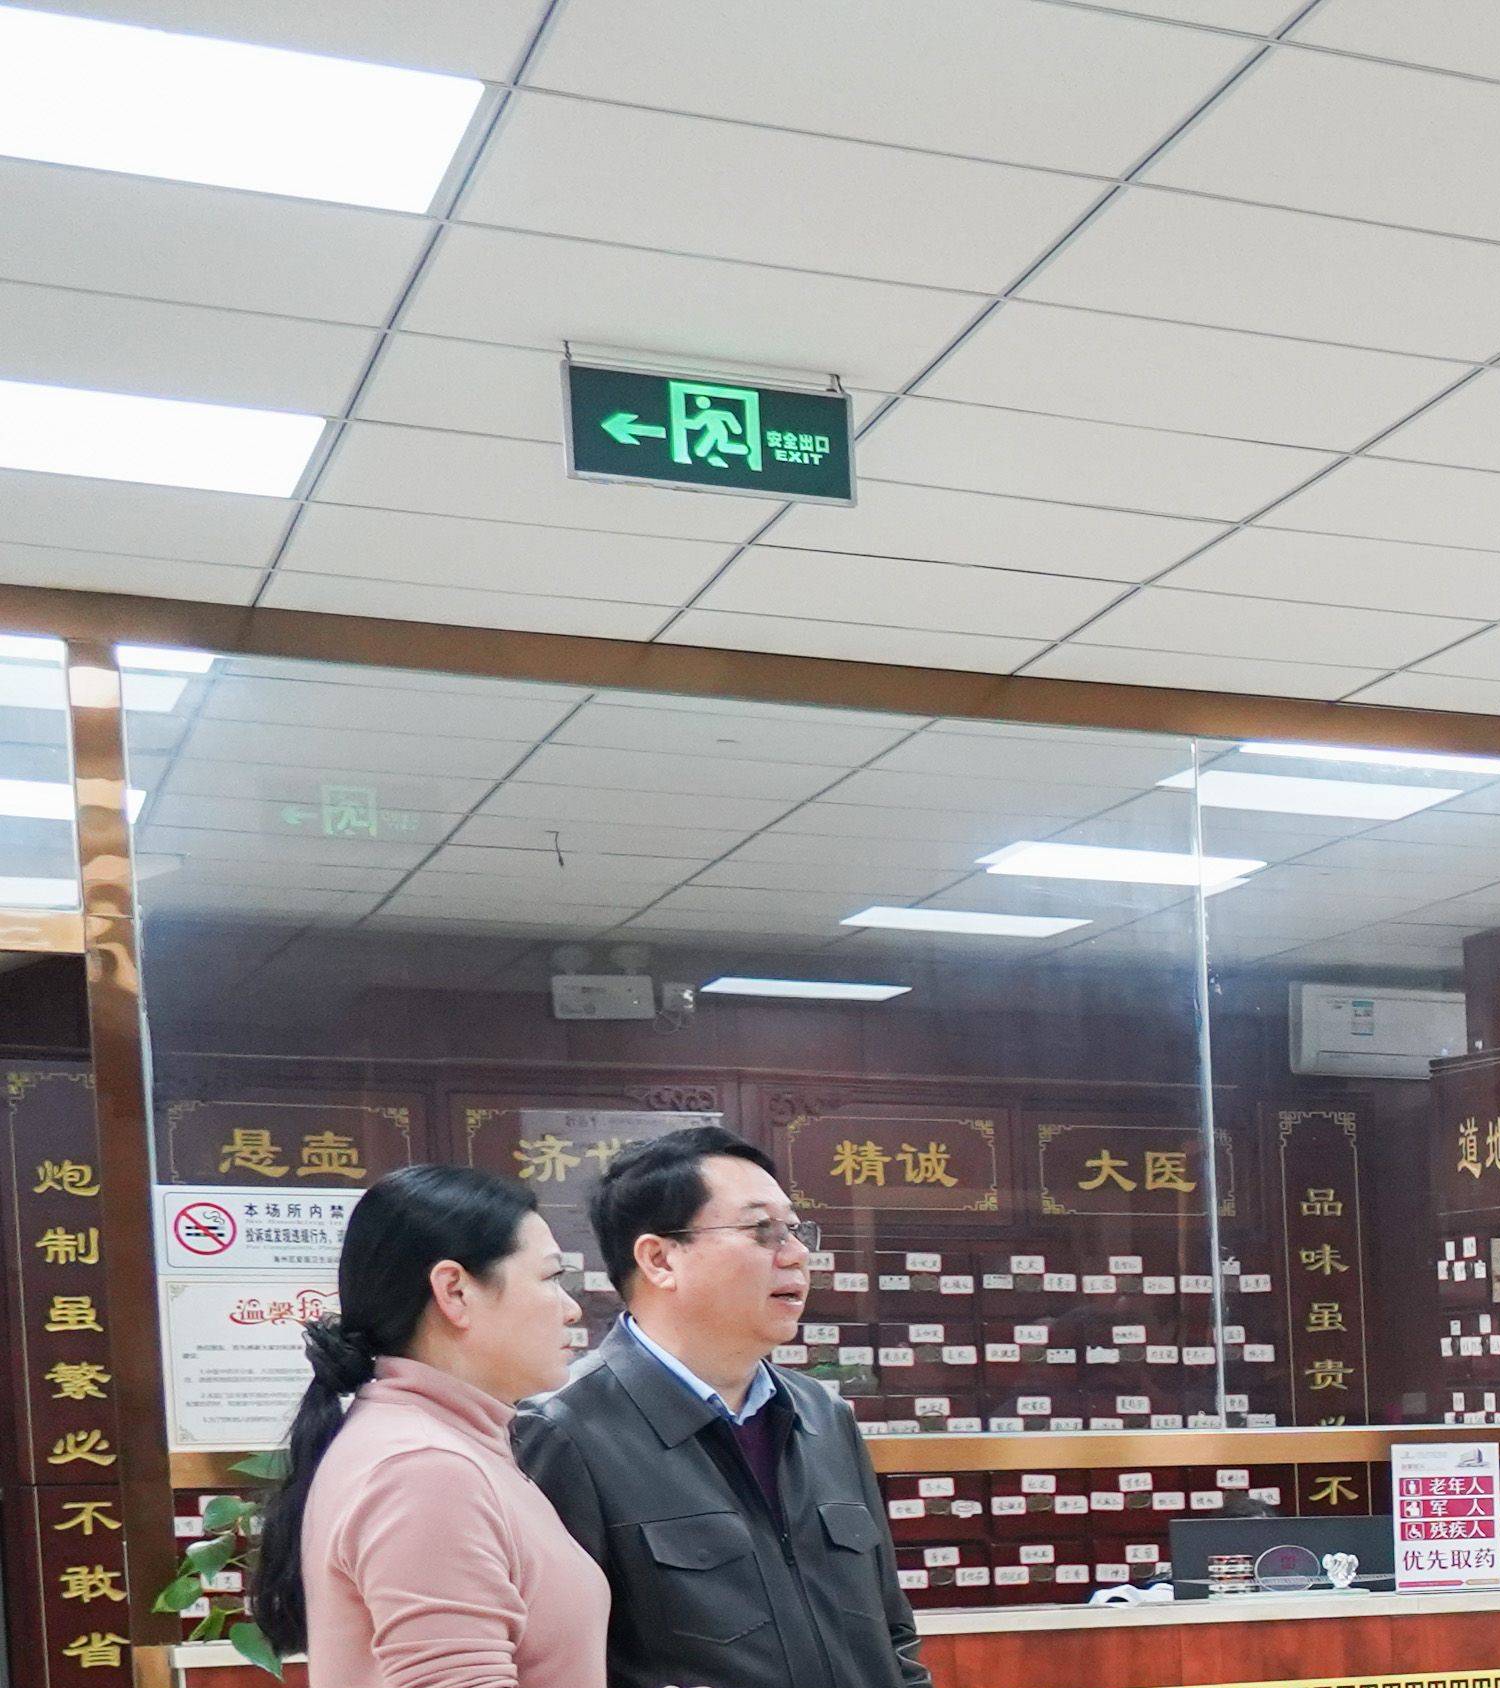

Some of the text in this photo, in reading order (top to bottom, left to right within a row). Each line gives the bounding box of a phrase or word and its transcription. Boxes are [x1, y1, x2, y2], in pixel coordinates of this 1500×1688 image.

[766, 430, 830, 453] 安全出口
[775, 450, 823, 466] EXIT
[219, 1129, 367, 1179] 悬壶
[830, 1140, 959, 1188] 精诚
[1078, 1149, 1196, 1193] 大医
[1429, 1477, 1485, 1495] 老年人
[1430, 1498, 1485, 1517] 军 人
[1430, 1521, 1486, 1539] 残疾人
[1404, 1548, 1495, 1571] 优先取药
